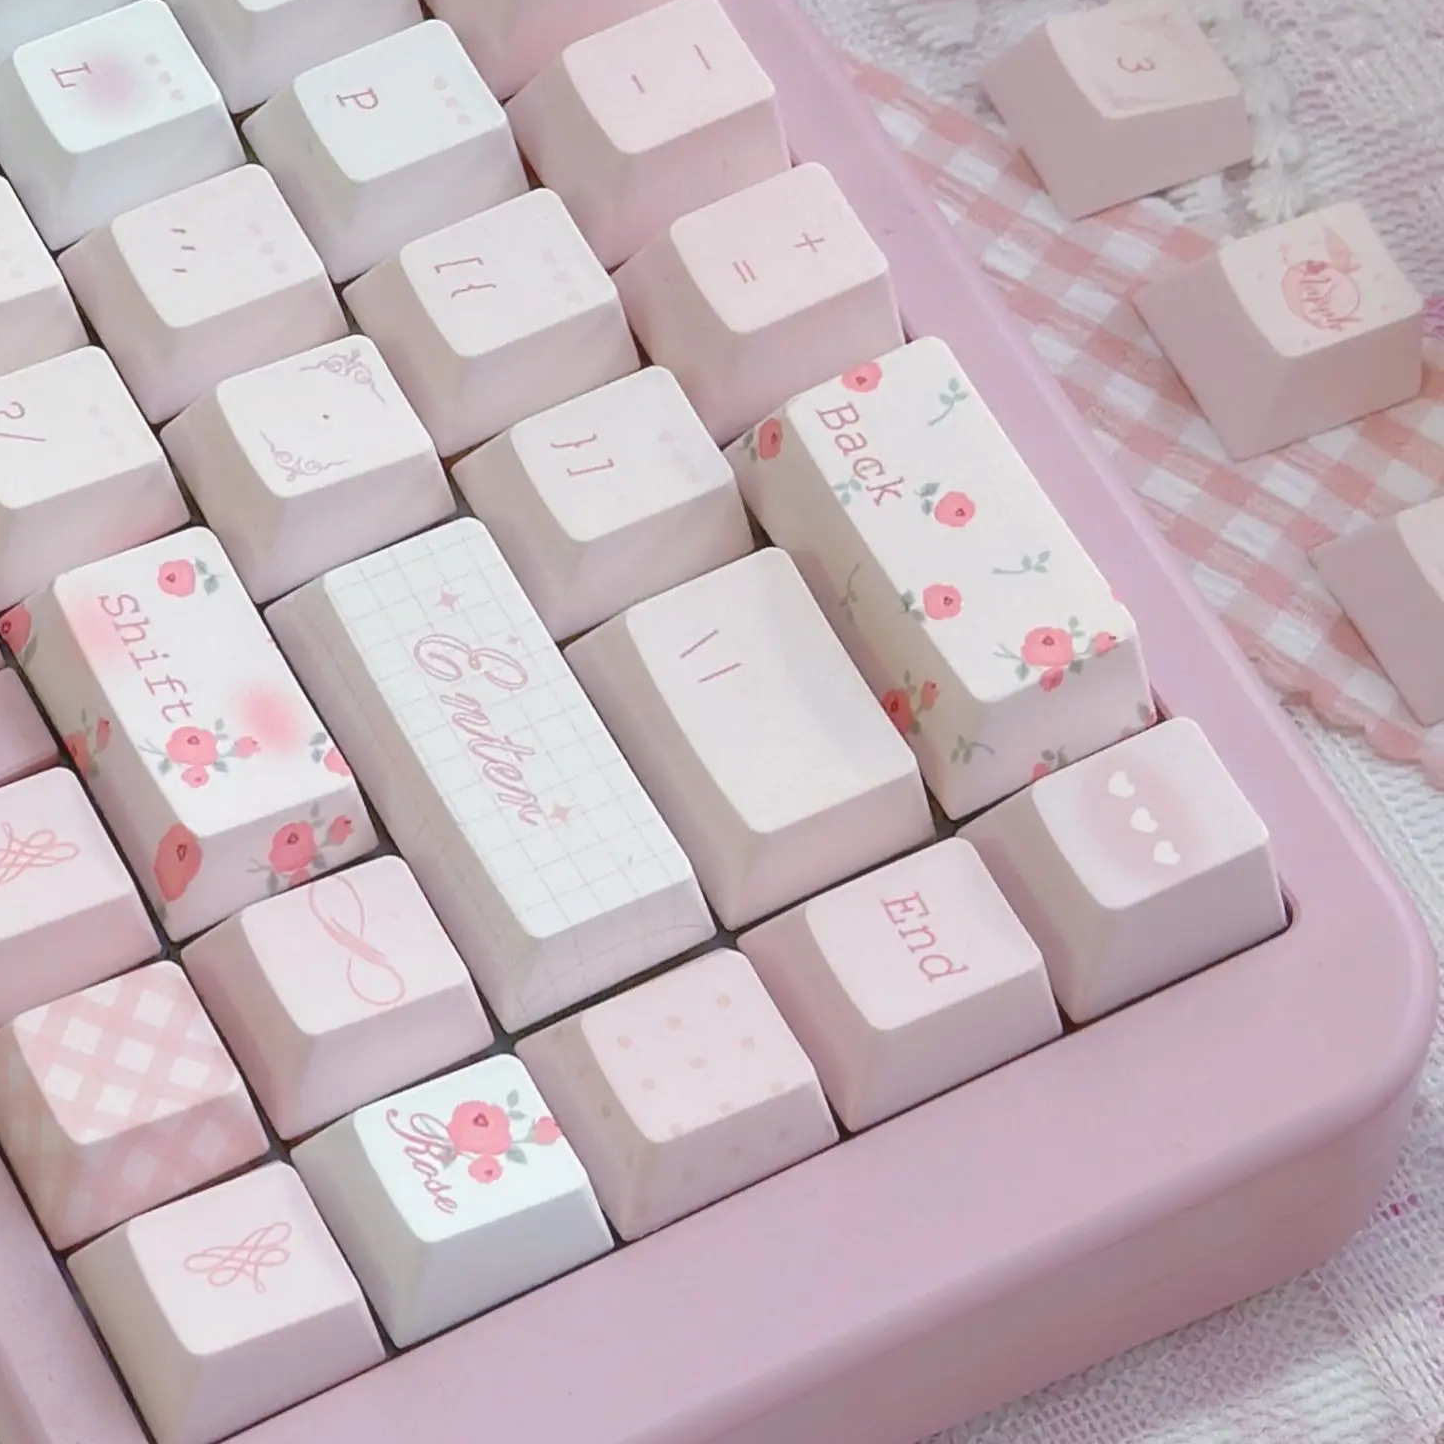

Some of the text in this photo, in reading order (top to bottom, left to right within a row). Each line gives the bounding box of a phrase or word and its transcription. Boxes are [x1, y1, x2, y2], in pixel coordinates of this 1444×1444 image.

[50, 61, 93, 89] L
[336, 87, 378, 110] P
[814, 401, 908, 507] Back
[96, 592, 195, 724] Shift
[414, 634, 543, 826] Enter
[880, 892, 970, 984] End
[385, 1109, 459, 1216] Rose
